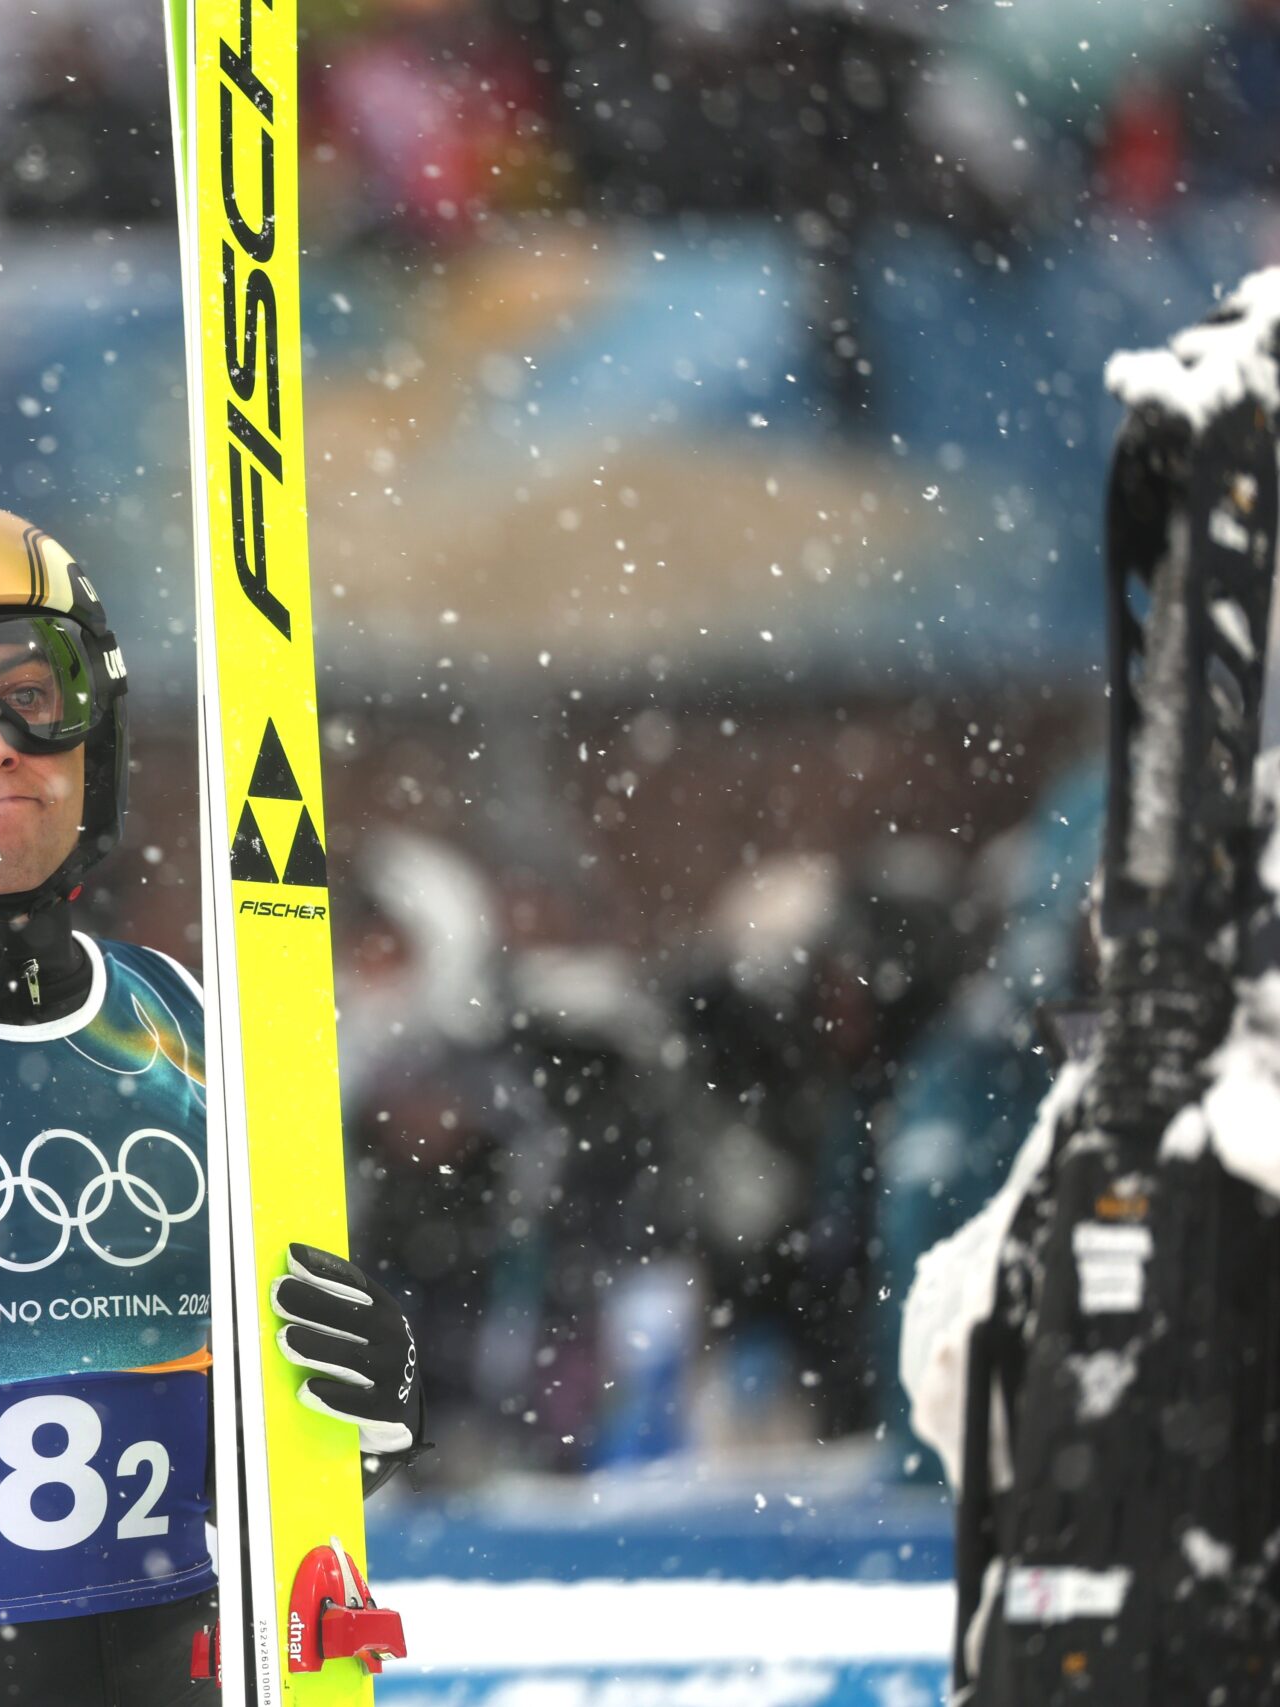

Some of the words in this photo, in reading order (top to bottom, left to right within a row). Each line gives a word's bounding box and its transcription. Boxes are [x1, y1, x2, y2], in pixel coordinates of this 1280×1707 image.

[239, 900, 326, 920] FISCHER
[48, 1294, 173, 1320] CORTINA
[178, 1293, 210, 1315] 2026
